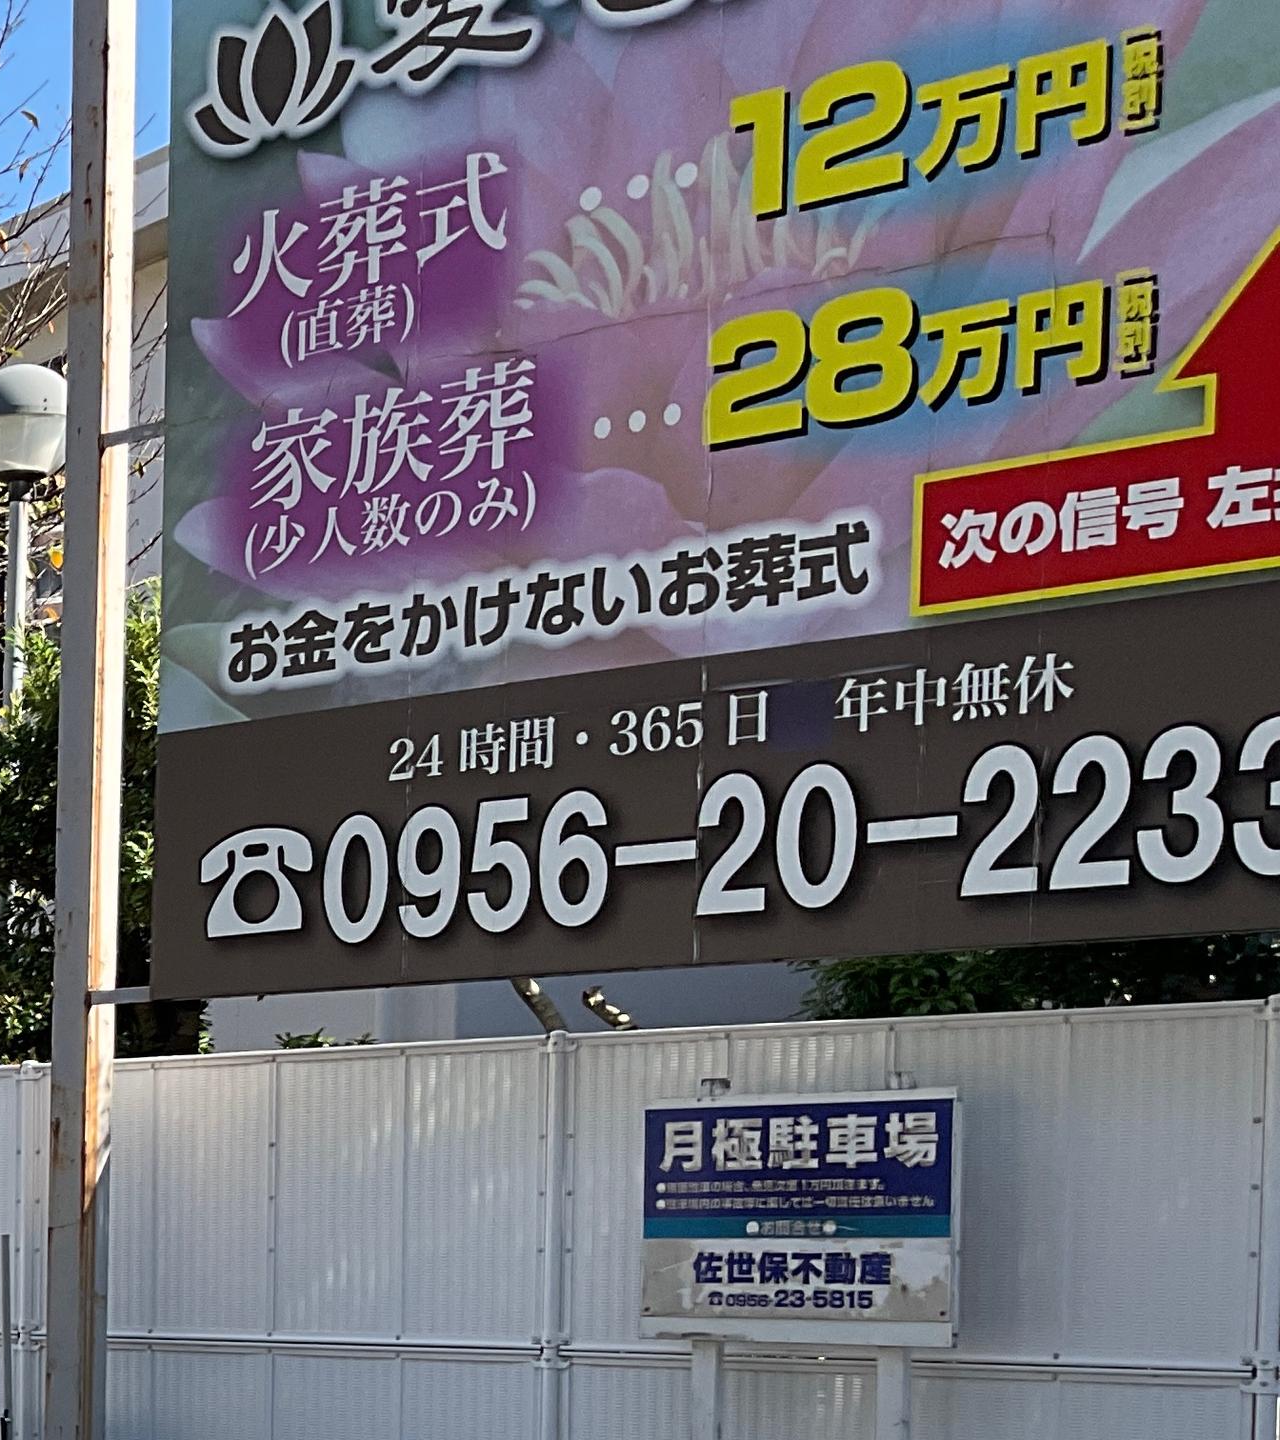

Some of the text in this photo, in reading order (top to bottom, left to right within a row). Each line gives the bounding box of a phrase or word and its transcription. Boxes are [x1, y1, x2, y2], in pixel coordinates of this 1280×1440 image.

[227, 152, 508, 318] 火葬式
[729, 38, 1111, 220] 12万円
[281, 282, 415, 368] (直葬)
[249, 359, 537, 511] 家族葬
[703, 279, 1110, 451] 28万円
[244, 470, 536, 580] (少人数のみ)
[939, 466, 1280, 569] 次の信号 左
[227, 520, 870, 684] お金をかけないお葬式
[834, 653, 1075, 735] 年中無休
[659, 1112, 939, 1173] 月極駐車場
[693, 1251, 892, 1285] 佐世保不動産
